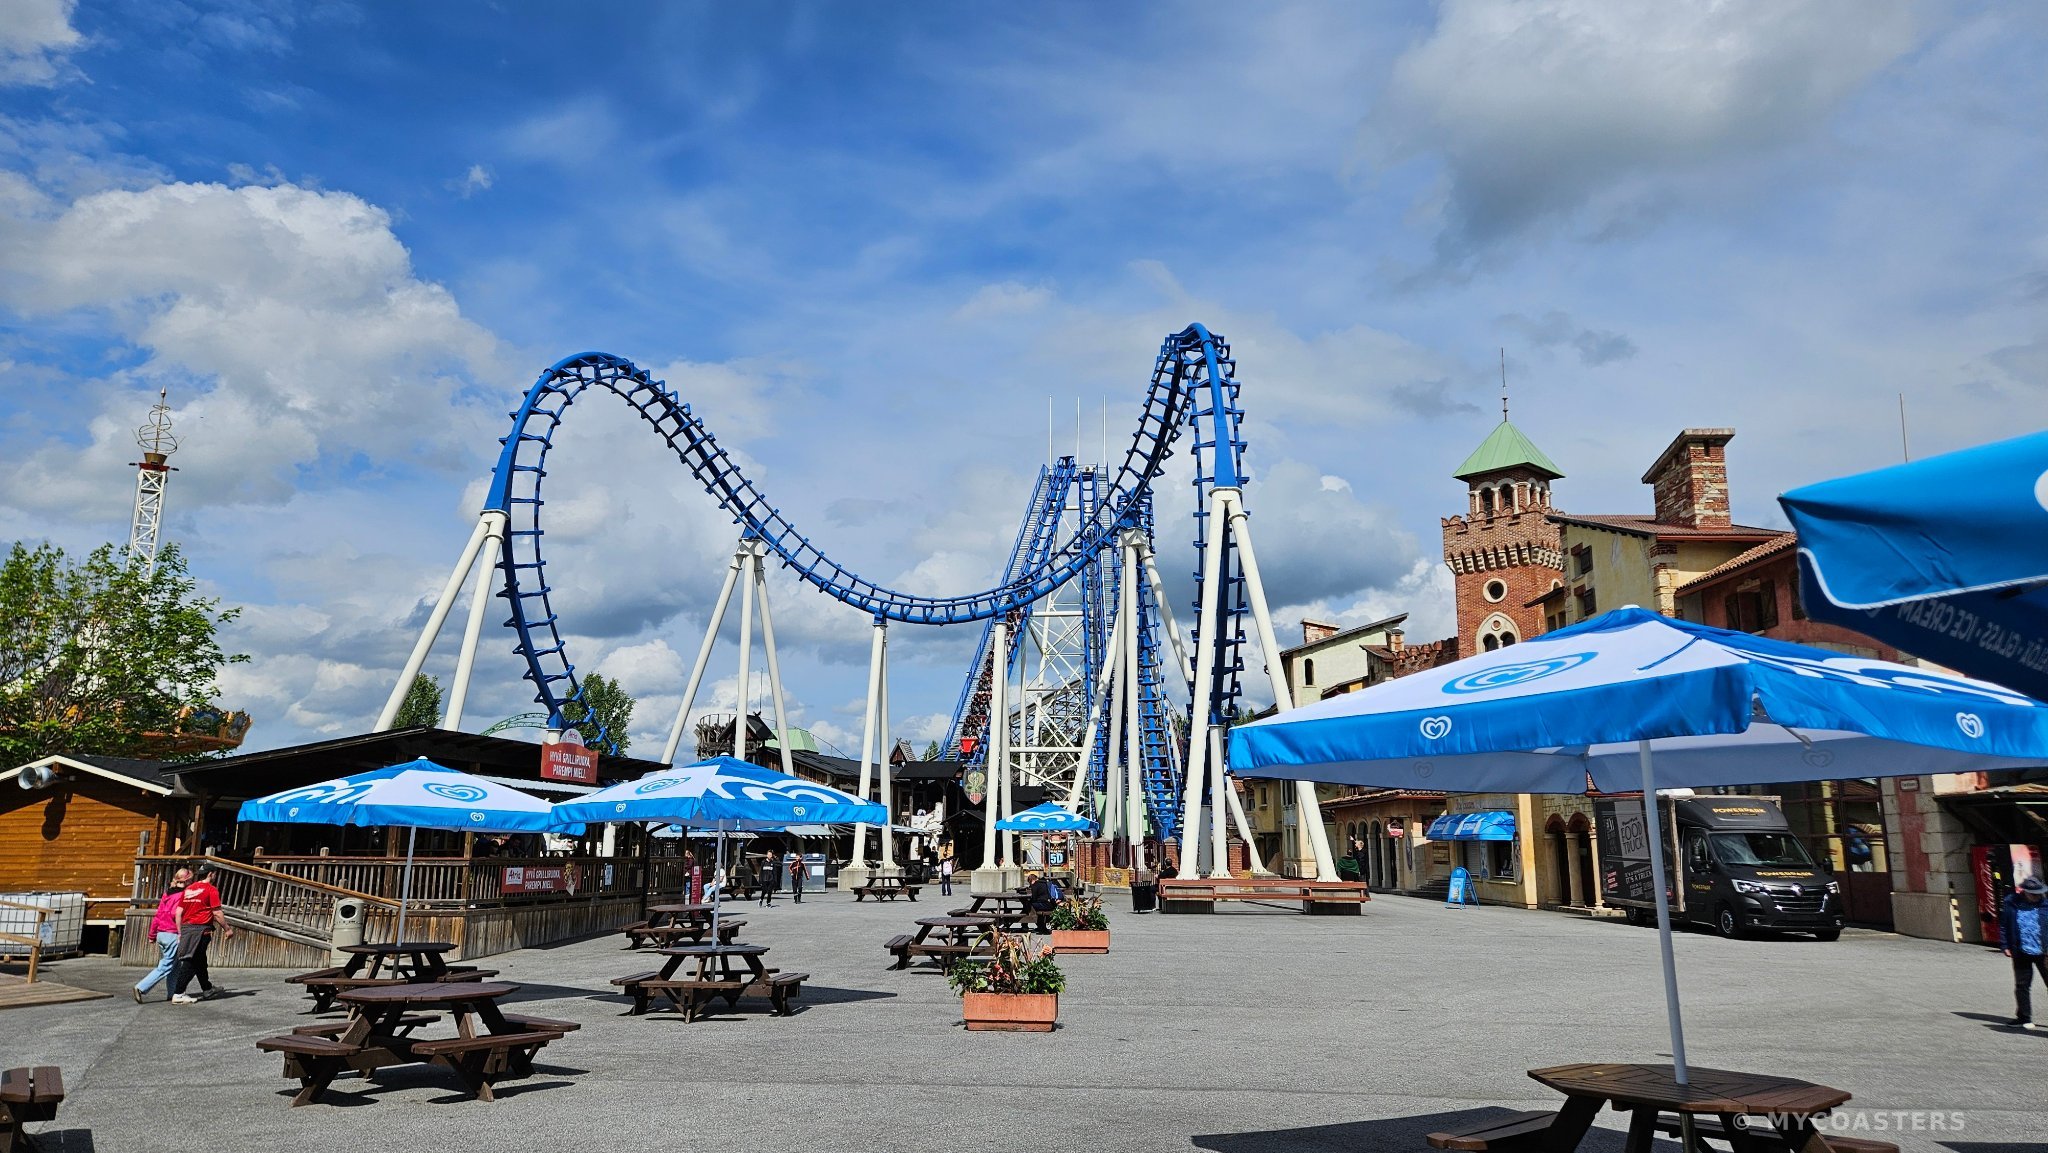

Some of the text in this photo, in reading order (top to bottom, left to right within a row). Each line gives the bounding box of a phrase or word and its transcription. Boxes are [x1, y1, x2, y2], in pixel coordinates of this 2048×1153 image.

[1712, 806, 1767, 814] POWERPARK
[1620, 821, 1643, 841] FOOD
[1622, 836, 1645, 855] TRUCK
[1050, 853, 1063, 864] 5D
